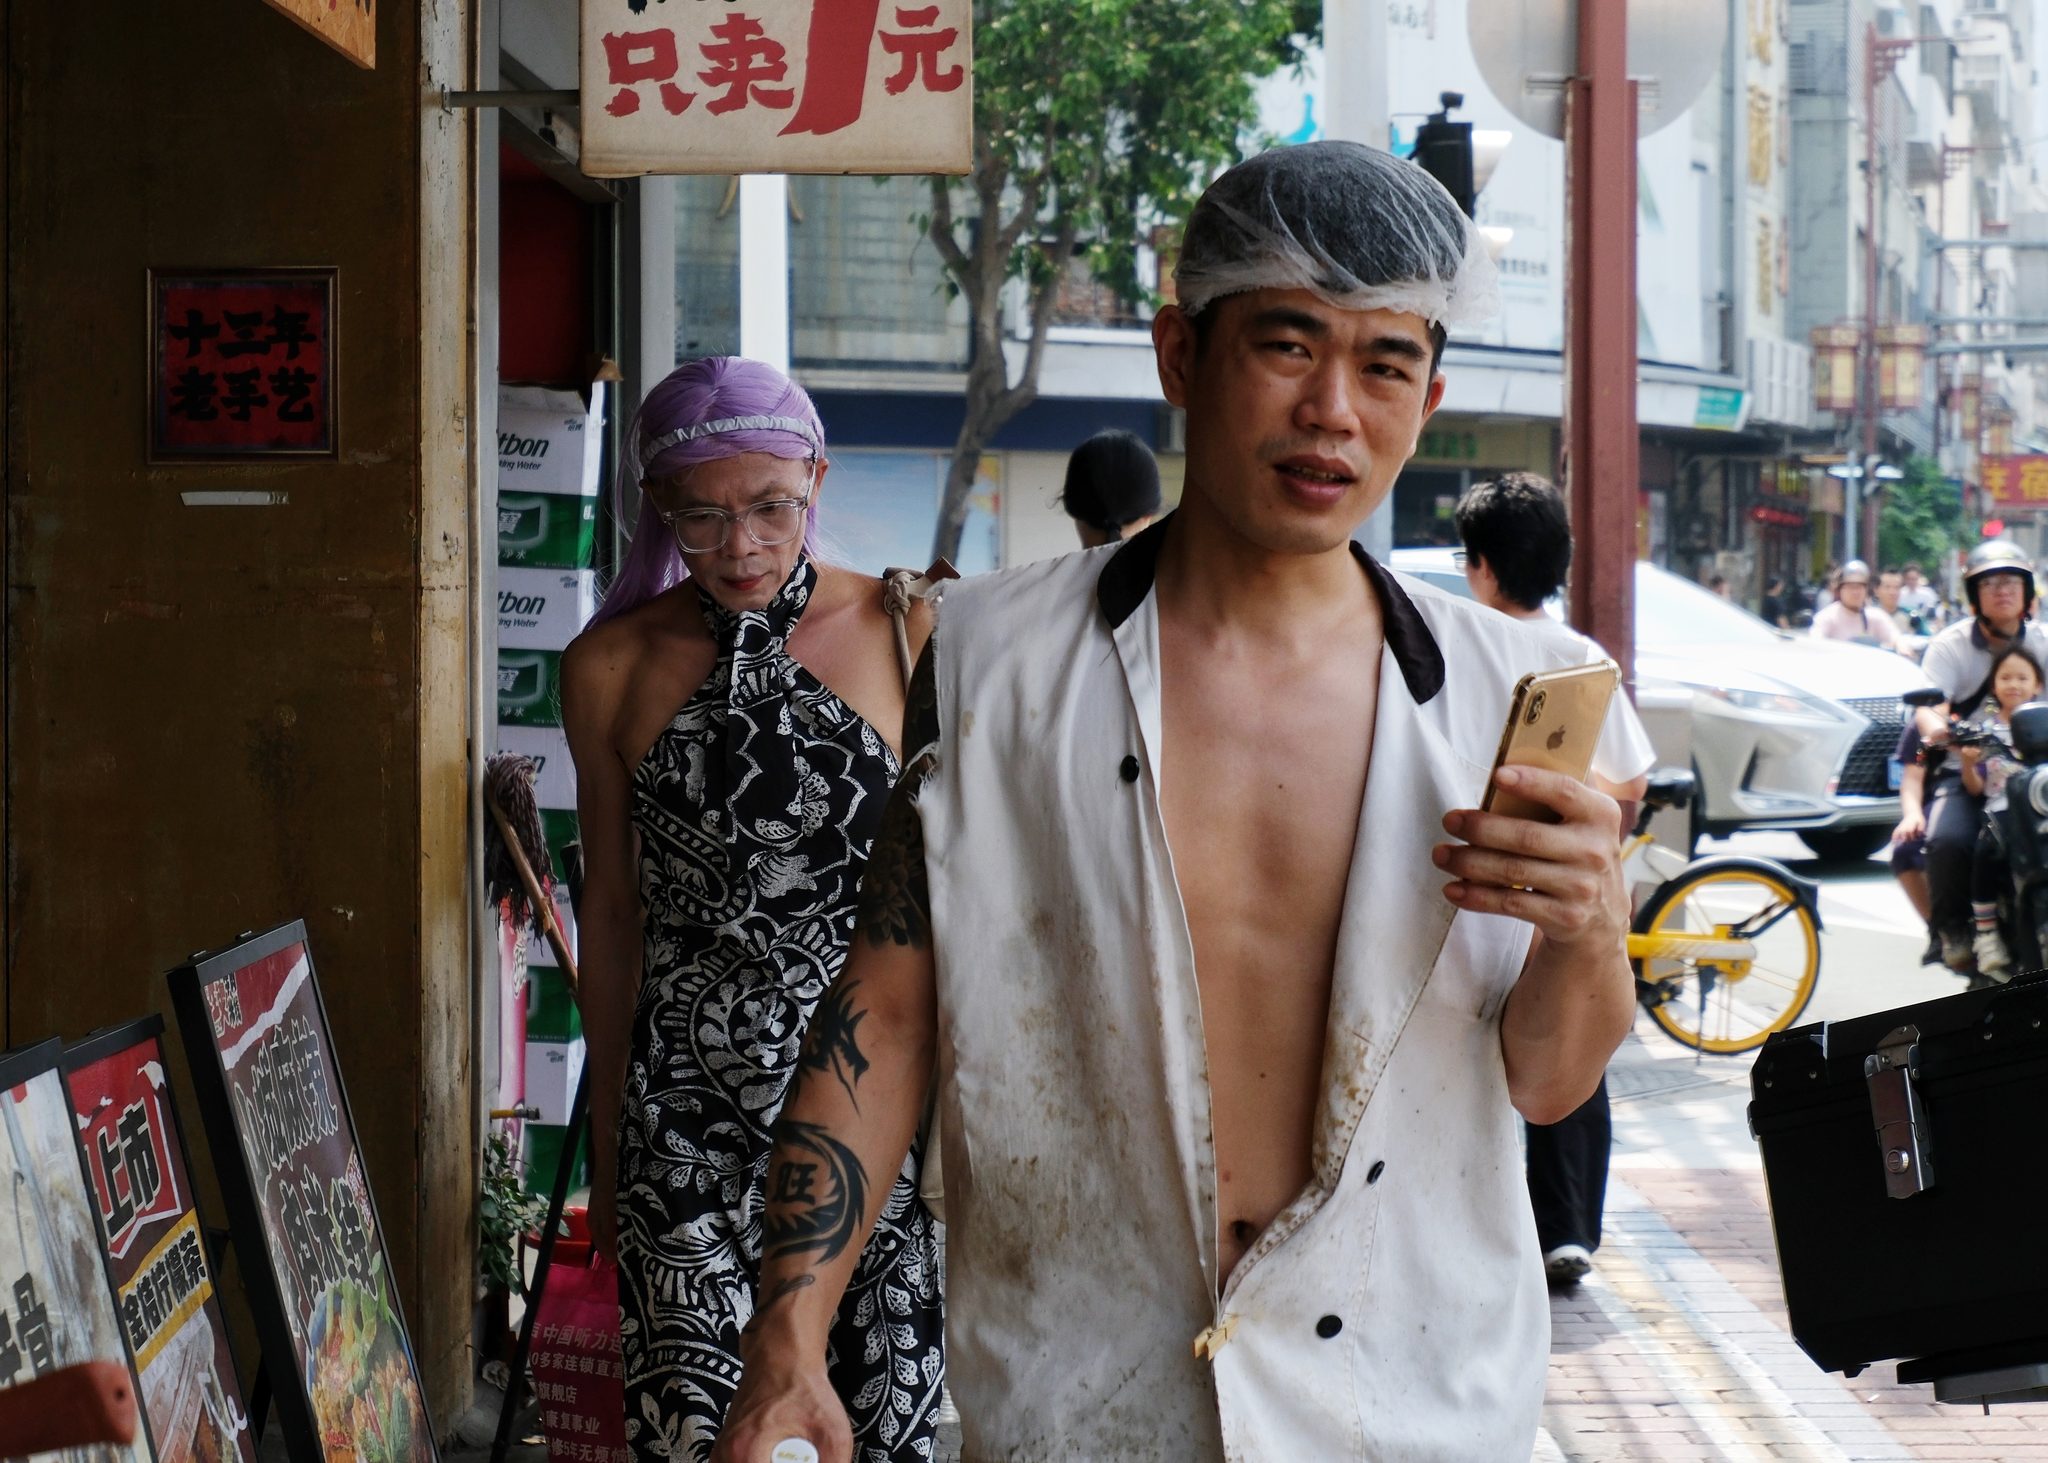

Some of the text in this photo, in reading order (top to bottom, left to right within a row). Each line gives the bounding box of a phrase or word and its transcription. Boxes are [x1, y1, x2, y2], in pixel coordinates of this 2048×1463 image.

[168, 304, 317, 360] 十三年
[169, 365, 317, 422] 老手艺
[517, 459, 542, 471] Water
[513, 618, 538, 629] Water
[84, 1098, 160, 1250] 上市
[530, 1352, 623, 1380] 0多家连锁直营
[542, 1409, 601, 1435] 康复事业
[547, 1437, 627, 1463] 修5年无烦恼
